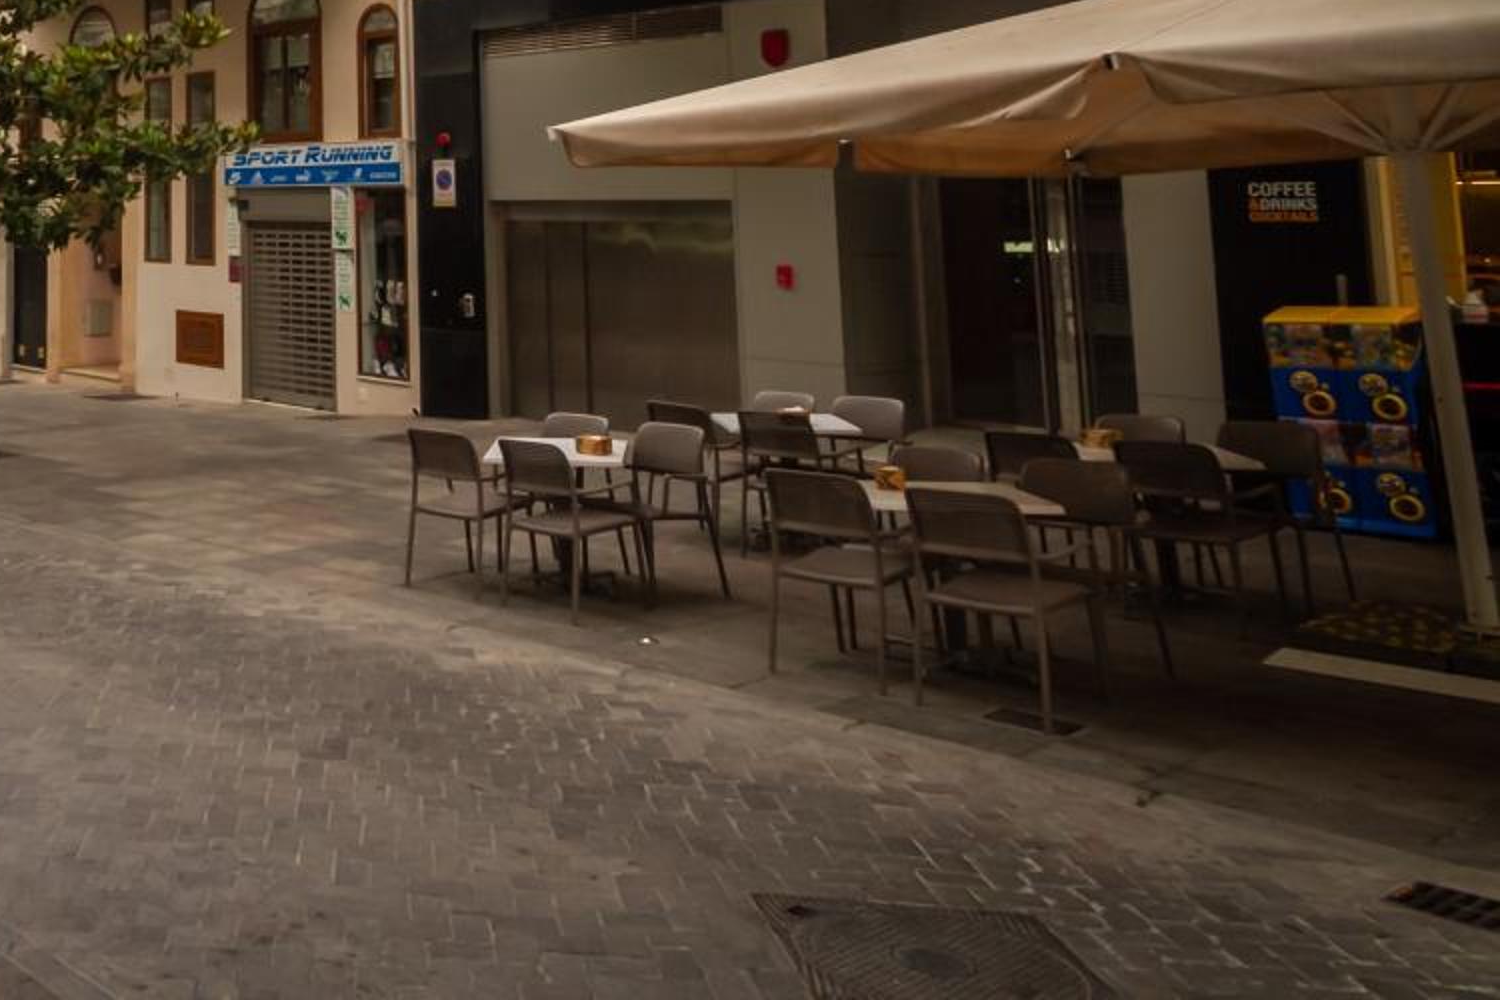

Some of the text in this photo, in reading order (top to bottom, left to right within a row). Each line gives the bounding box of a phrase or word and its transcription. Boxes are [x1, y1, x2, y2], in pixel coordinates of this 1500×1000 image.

[233, 145, 394, 166] SPORT RUNNING
[1247, 181, 1317, 197] COFFEE
